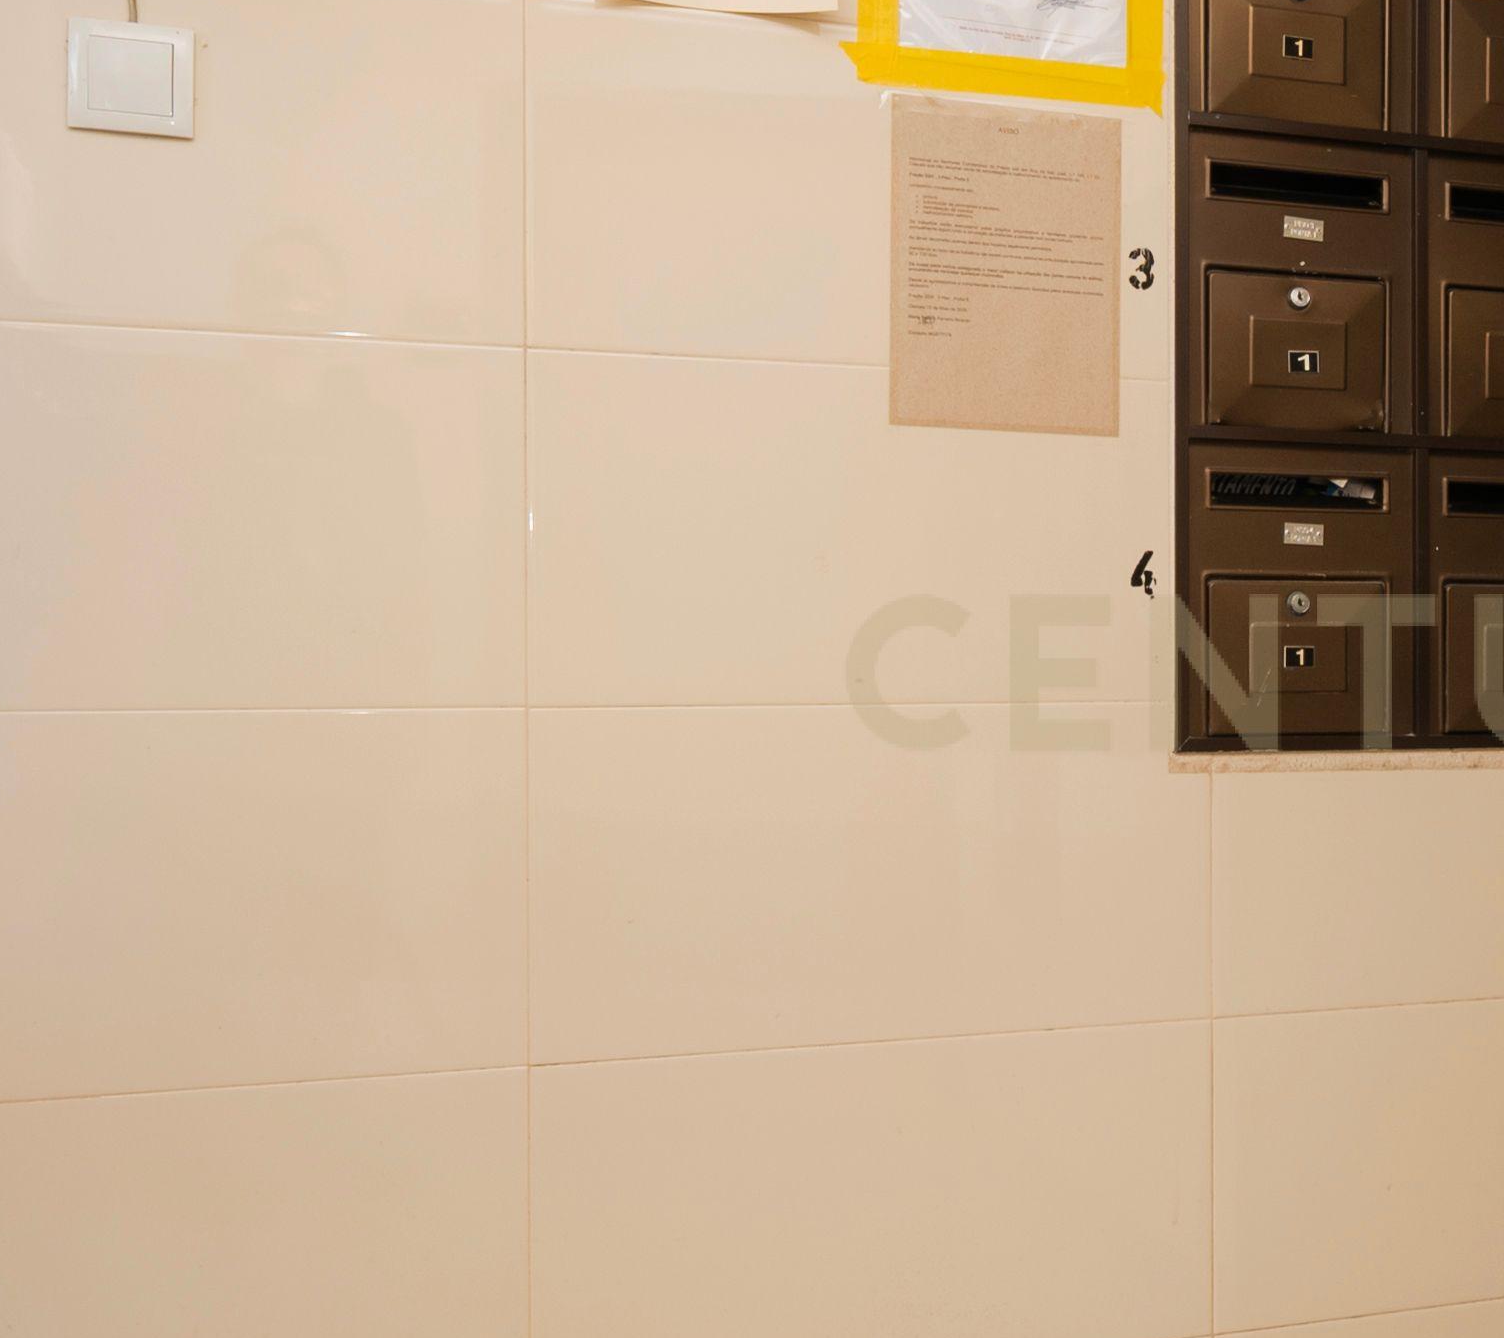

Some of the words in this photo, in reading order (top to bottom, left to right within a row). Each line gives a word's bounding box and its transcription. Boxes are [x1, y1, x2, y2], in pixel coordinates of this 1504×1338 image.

[1294, 39, 1305, 57] 1
[1128, 247, 1155, 291] 3
[1296, 353, 1312, 372] 1
[1129, 550, 1157, 599] 4
[1295, 648, 1306, 666] 1
